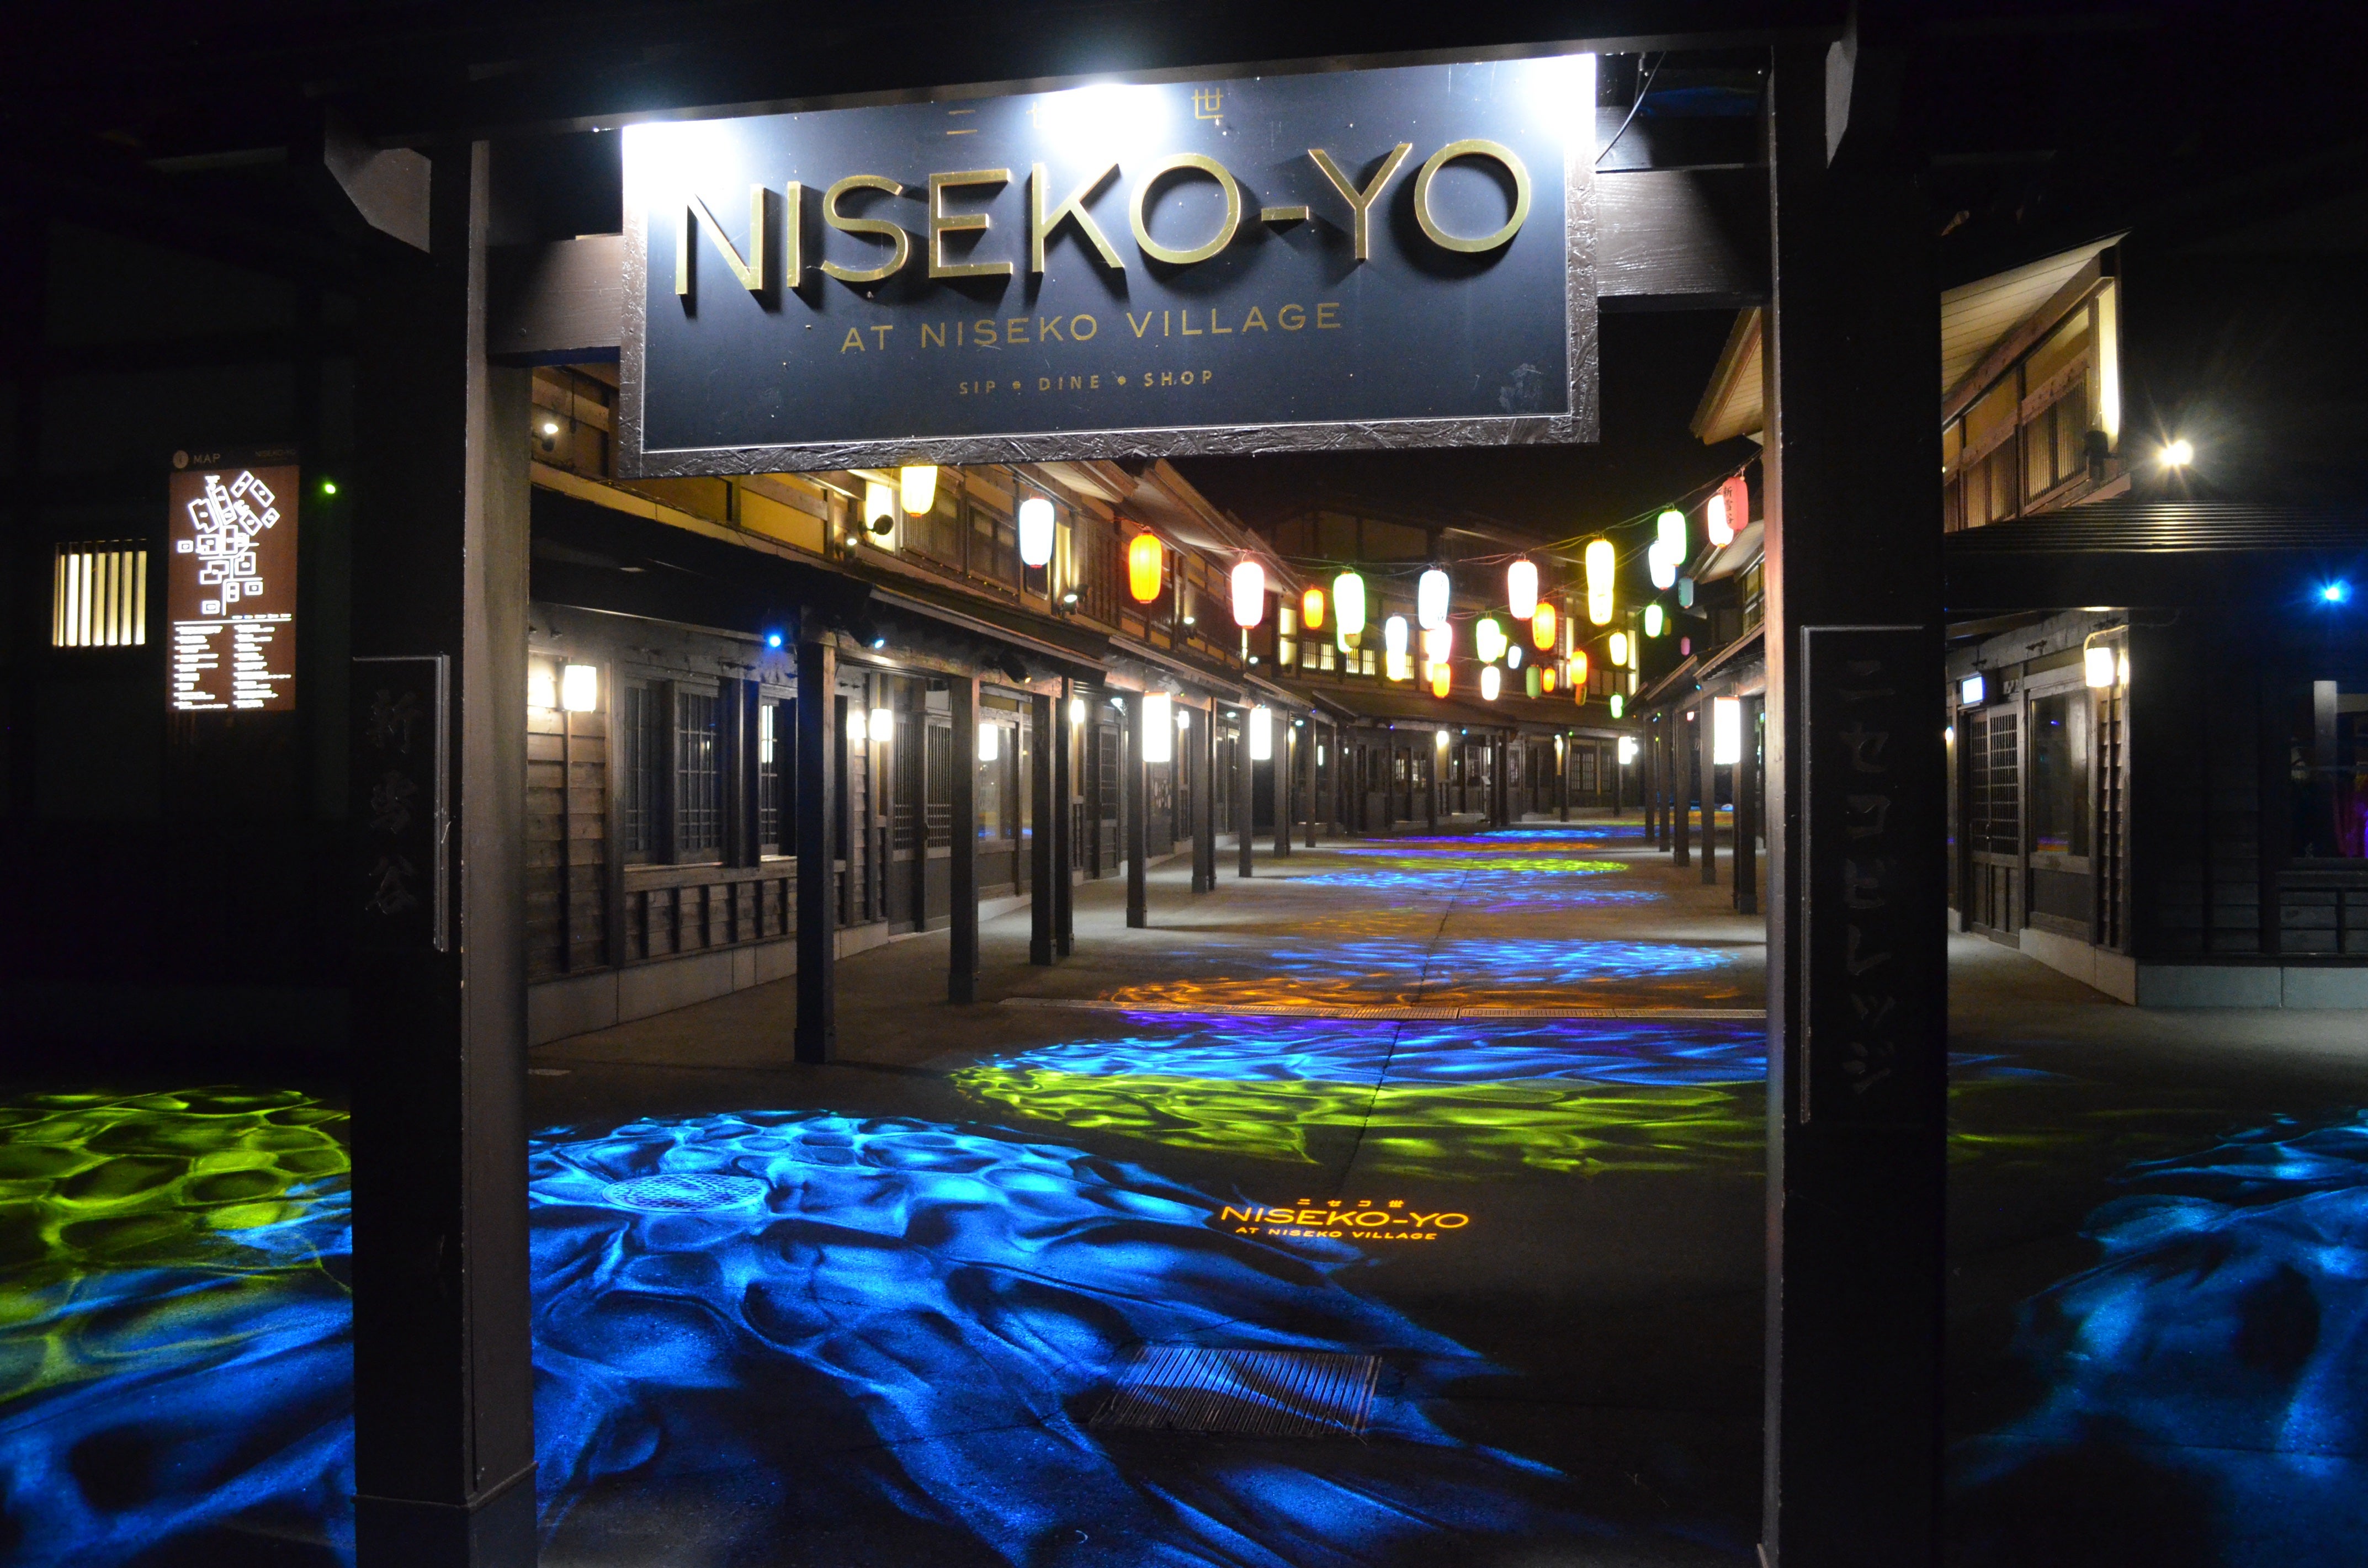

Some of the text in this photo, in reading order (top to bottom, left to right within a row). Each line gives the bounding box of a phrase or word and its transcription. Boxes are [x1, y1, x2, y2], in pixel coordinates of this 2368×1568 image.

[675, 139, 1532, 295] NISEKO-YO
[841, 302, 1341, 352] AT NISEKO VILLAGE
[959, 370, 1213, 395] SIP DINE SHOP
[194, 453, 221, 464] MAP
[1221, 1206, 1469, 1228] NISEKO-YO
[1268, 1229, 1343, 1238] NISEKO
[1352, 1231, 1437, 1240] VILLAGE
